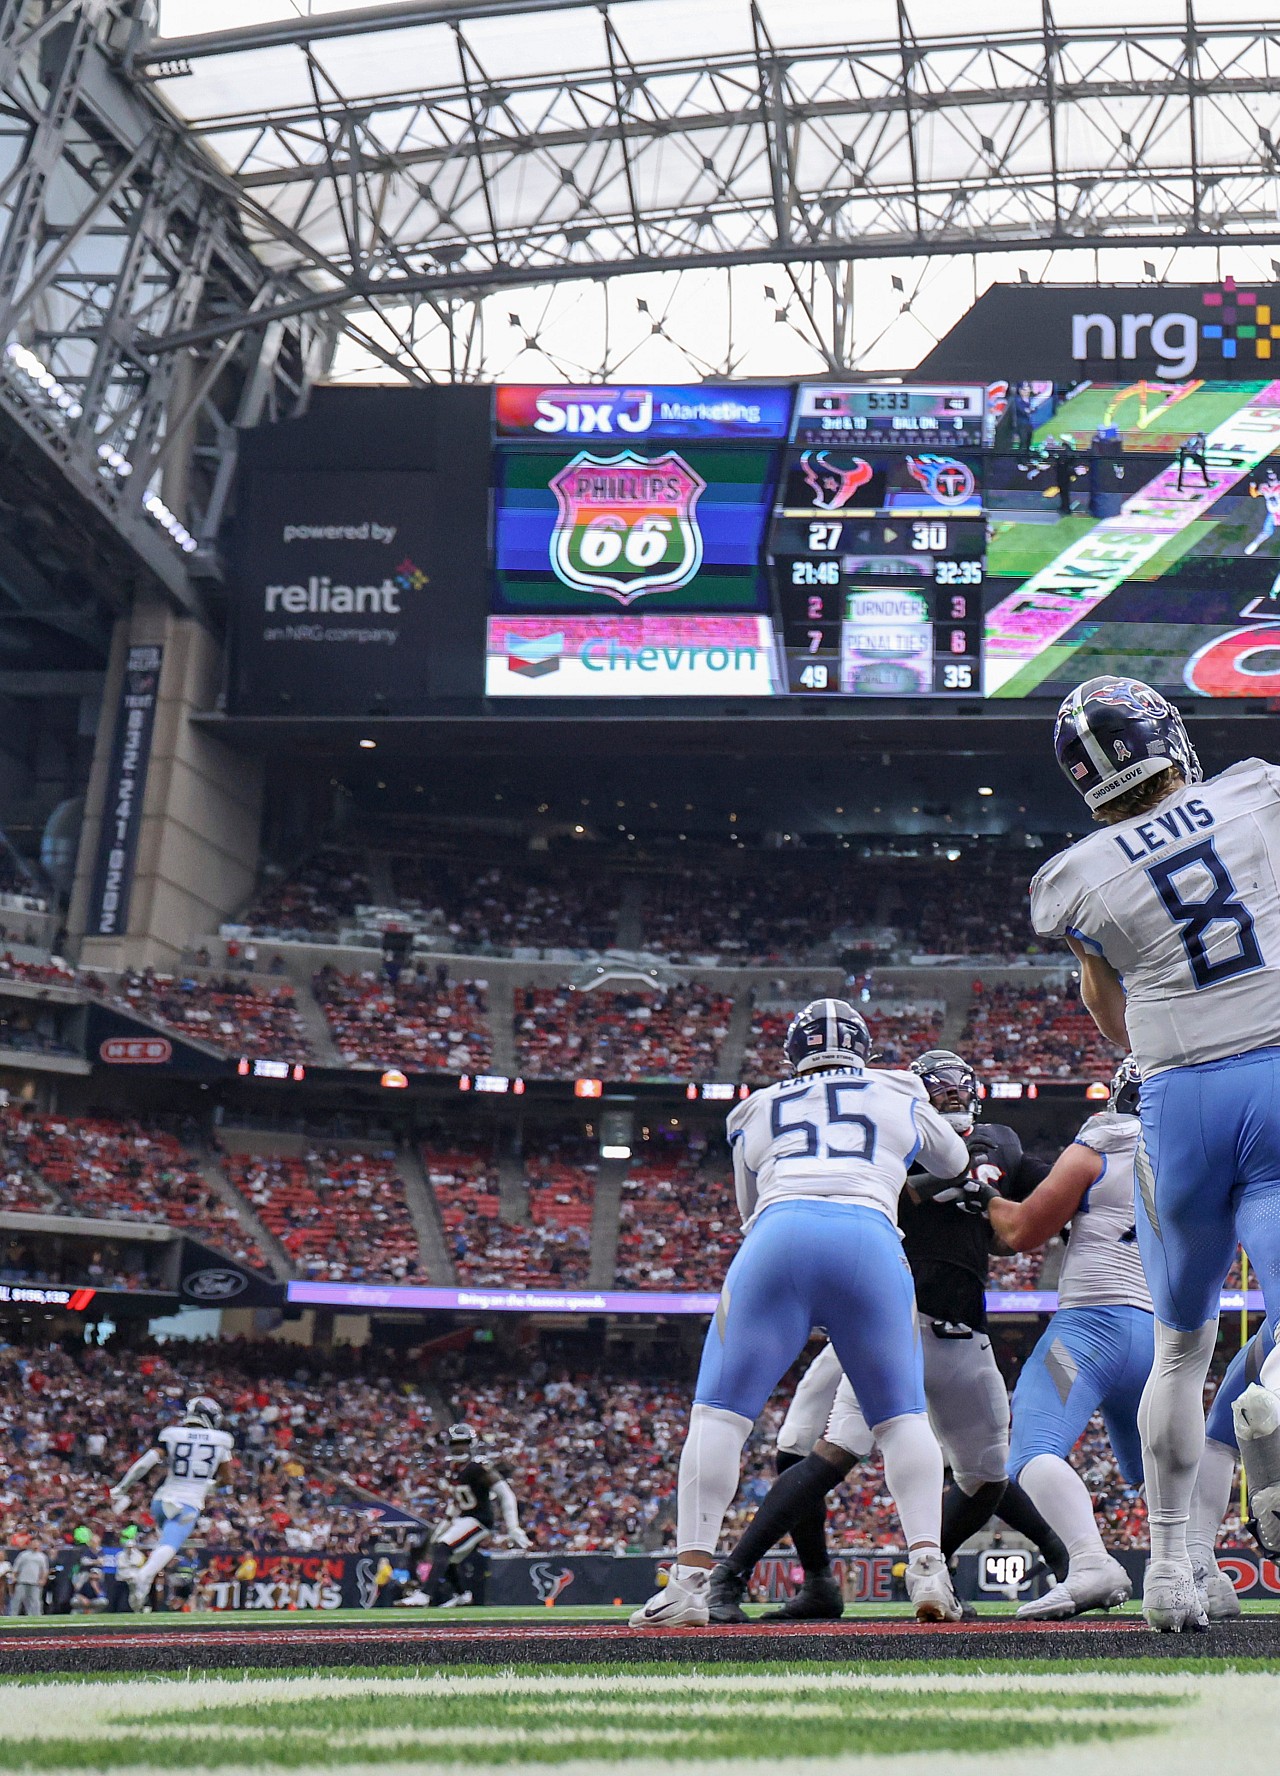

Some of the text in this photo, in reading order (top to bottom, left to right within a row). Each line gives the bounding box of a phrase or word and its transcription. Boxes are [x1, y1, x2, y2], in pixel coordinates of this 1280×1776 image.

[1072, 312, 1198, 378] nrg
[617, 390, 653, 433] J
[661, 403, 760, 423] Marketing
[868, 393, 909, 409] 5:33
[953, 416, 963, 430] 3
[575, 475, 682, 502] PHILLIPS
[283, 522, 397, 544] powered by
[580, 514, 673, 568] 66
[809, 522, 843, 550] 27
[912, 522, 947, 550] 30
[792, 561, 839, 585] 21:46
[935, 561, 982, 585] 32:35
[1010, 531, 1150, 613] TAKES
[265, 576, 401, 614] reliant
[808, 596, 823, 619] 2
[263, 624, 398, 646] an NRG company
[808, 630, 823, 654] 7
[951, 630, 966, 654] 6
[580, 637, 757, 672] Chevron
[799, 665, 828, 689] 49
[944, 664, 972, 689] 35
[1092, 767, 1143, 800] CHOOSE LOVE
[1113, 799, 1216, 864] LEVIS
[1144, 834, 1266, 990] 8
[771, 1081, 878, 1164] 55
[174, 1442, 215, 1478] 83
[986, 1557, 1024, 1584] 40
